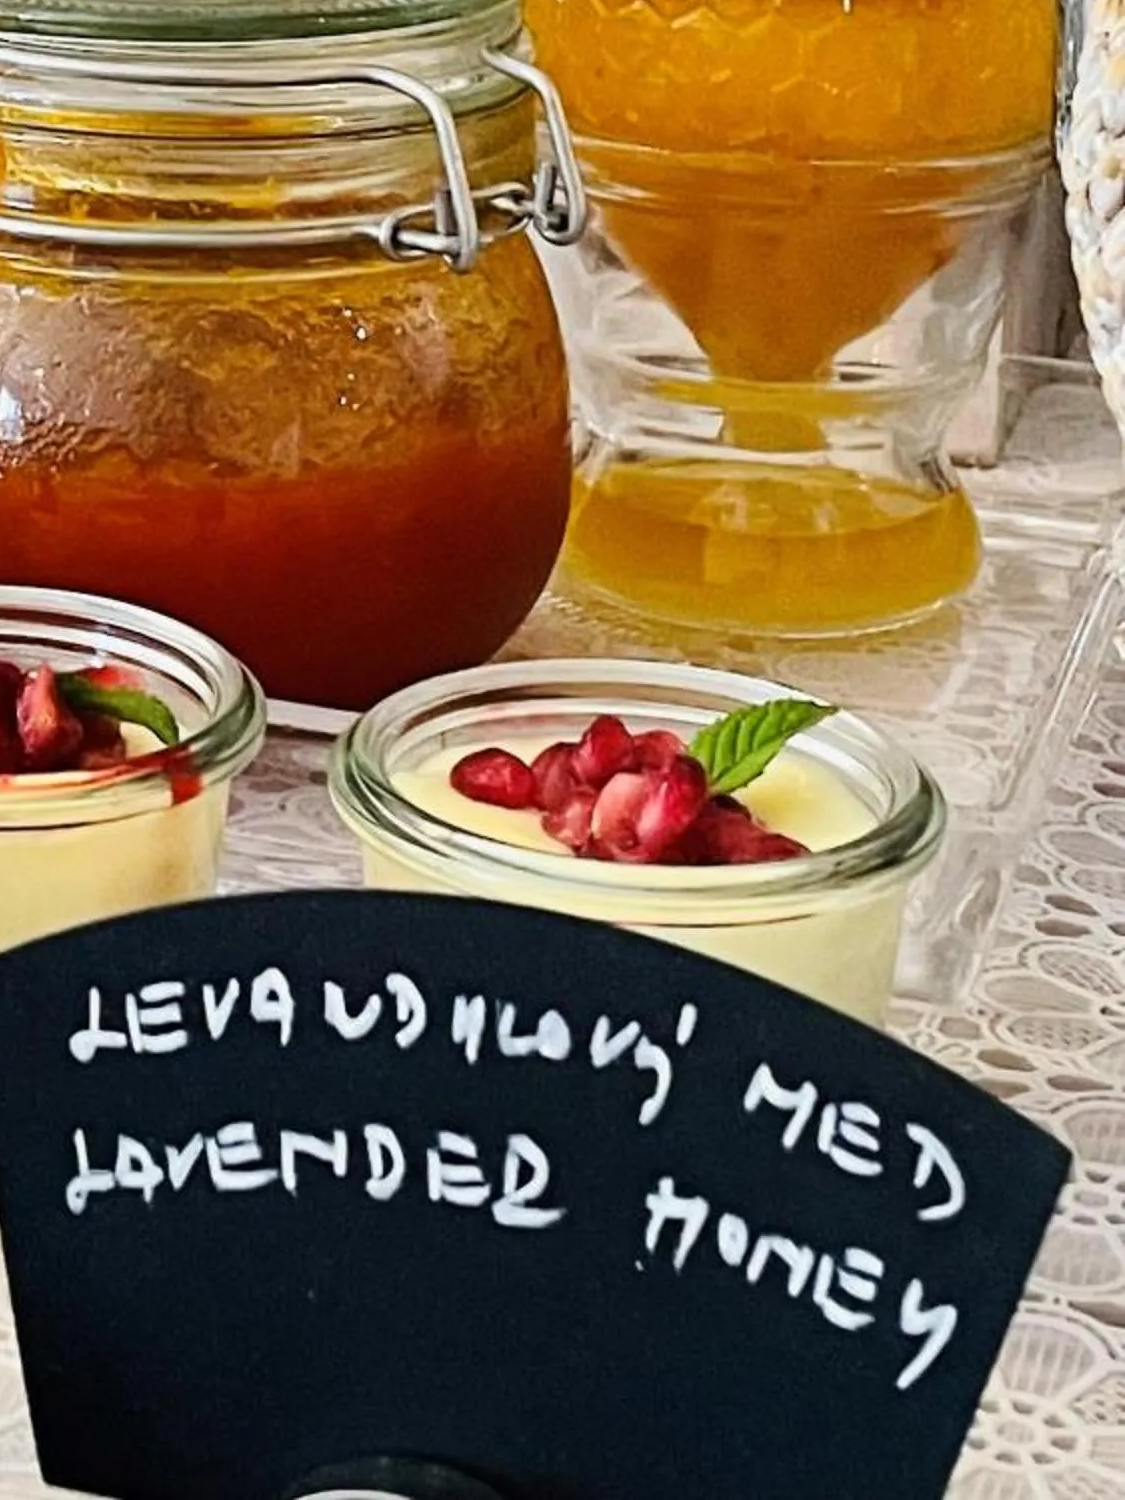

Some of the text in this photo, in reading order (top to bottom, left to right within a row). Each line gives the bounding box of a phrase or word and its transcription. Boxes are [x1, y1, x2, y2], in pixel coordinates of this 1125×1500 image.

[743, 1063, 966, 1222] MED
[66, 1122, 960, 1391] LAVENDER HONEY
